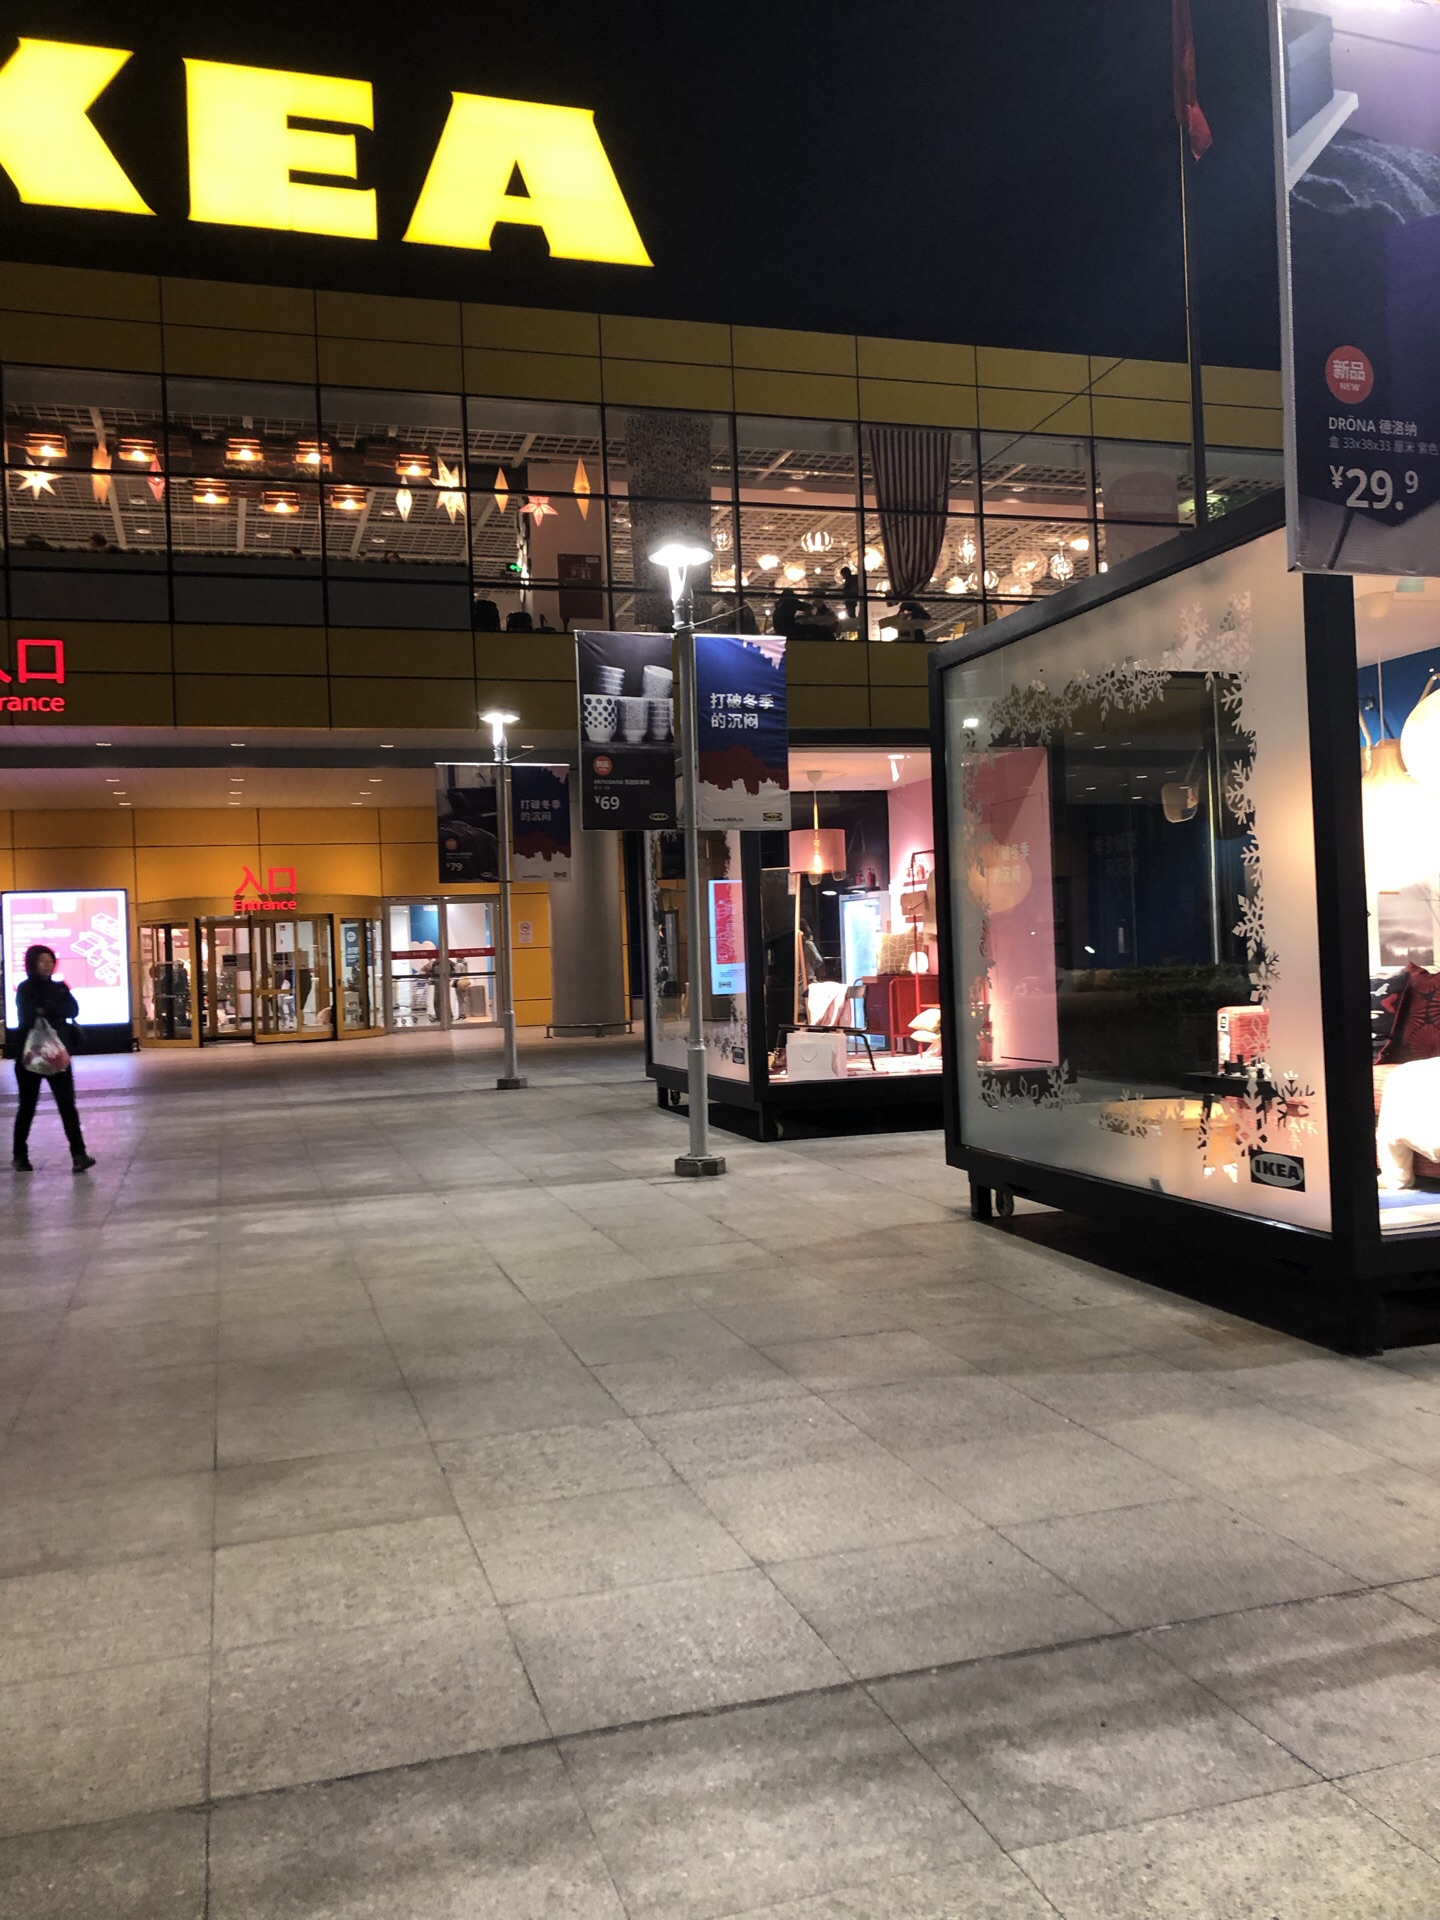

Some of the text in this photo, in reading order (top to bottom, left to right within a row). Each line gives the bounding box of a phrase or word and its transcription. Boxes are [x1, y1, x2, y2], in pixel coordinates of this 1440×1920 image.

[1332, 359, 1366, 382] 新品
[1339, 382, 1361, 392] NEW
[1379, 419, 1418, 437] 德洛纳
[0, 639, 65, 684] 口
[710, 692, 775, 710] 打破冬季
[711, 712, 759, 729] 的沉闷
[594, 795, 621, 810] ¥69
[234, 865, 297, 895] 入口
[233, 899, 297, 911] Entrance
[1254, 1159, 1301, 1181] IKEA
